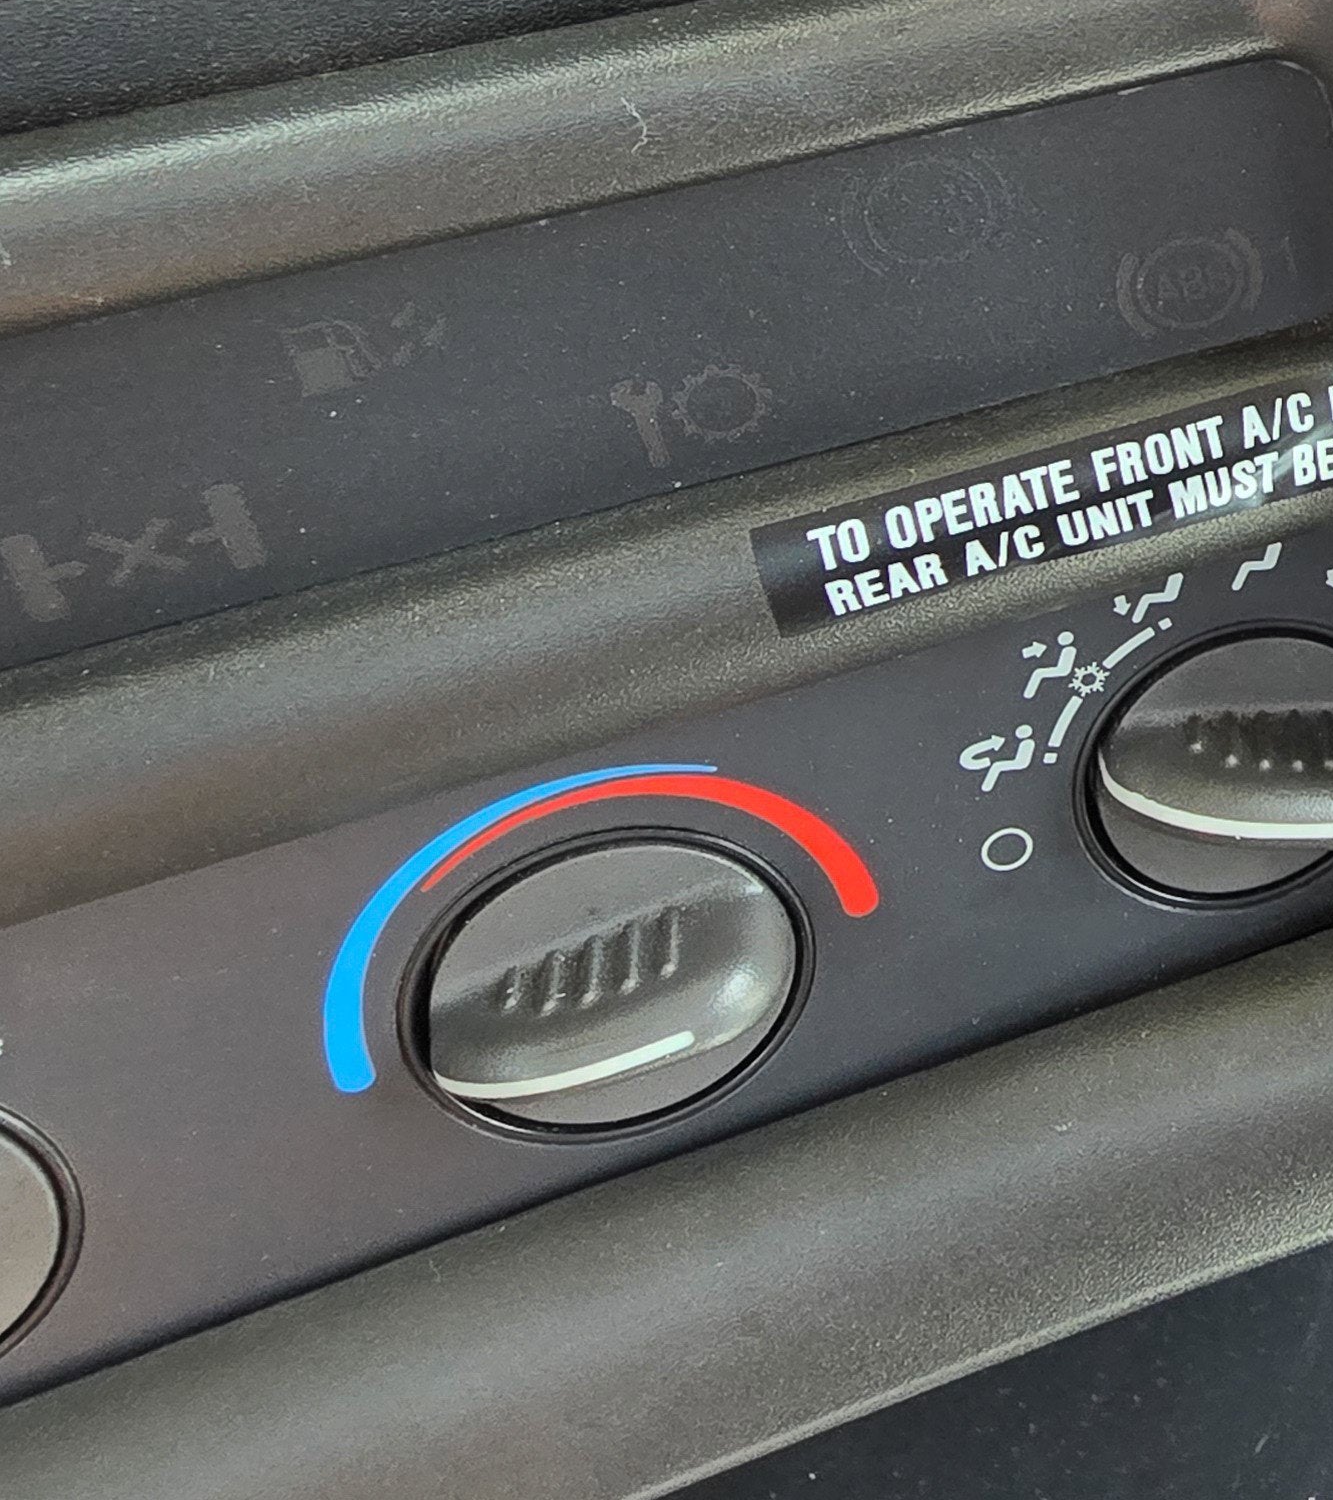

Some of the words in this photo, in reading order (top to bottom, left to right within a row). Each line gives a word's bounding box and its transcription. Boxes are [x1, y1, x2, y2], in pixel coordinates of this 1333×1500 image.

[807, 517, 869, 572] TO
[885, 460, 1080, 551] OPERATE
[1093, 415, 1224, 490] FRONT
[1242, 390, 1315, 445] A/C
[824, 557, 949, 616] REAR
[964, 531, 1045, 577] A/C
[1057, 490, 1155, 548] UNIT
[1170, 452, 1285, 519] MUST
